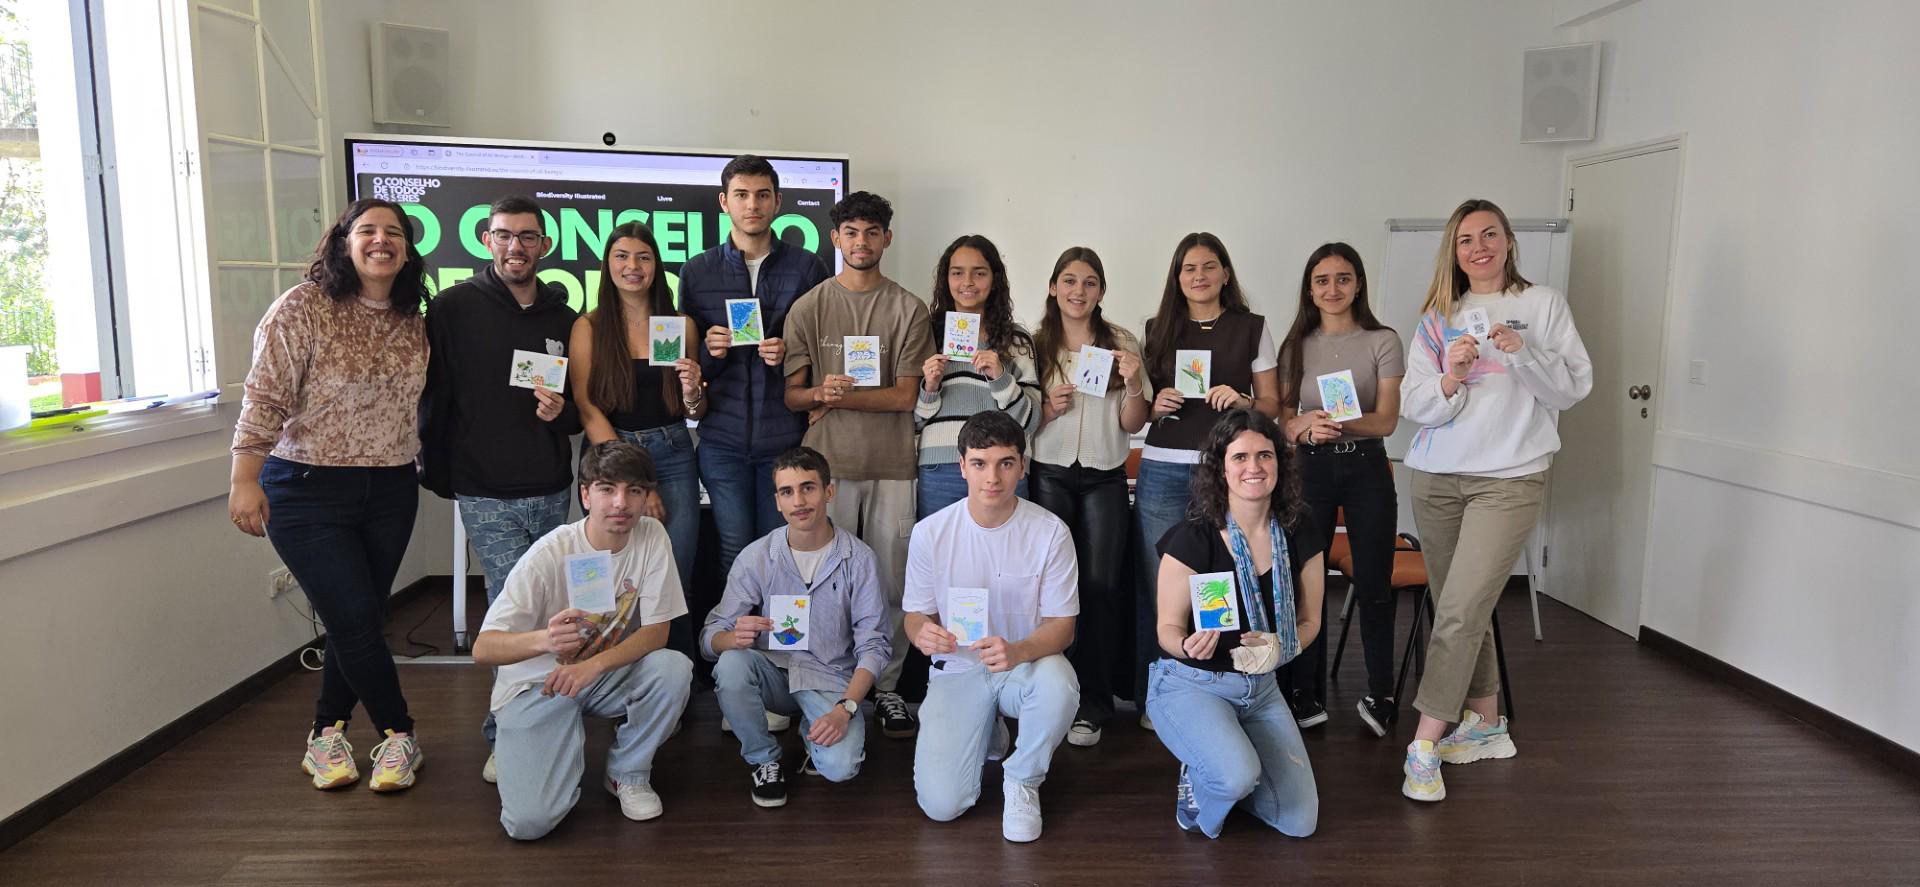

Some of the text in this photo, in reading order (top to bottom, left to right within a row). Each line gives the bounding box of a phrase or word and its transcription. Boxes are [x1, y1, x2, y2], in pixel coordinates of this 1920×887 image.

[373, 177, 441, 188] O CONSELHO
[374, 185, 426, 196] DE TODOS
[536, 192, 573, 200] Biodiversity
[374, 194, 389, 202] OS
[459, 204, 820, 263] CNELO
